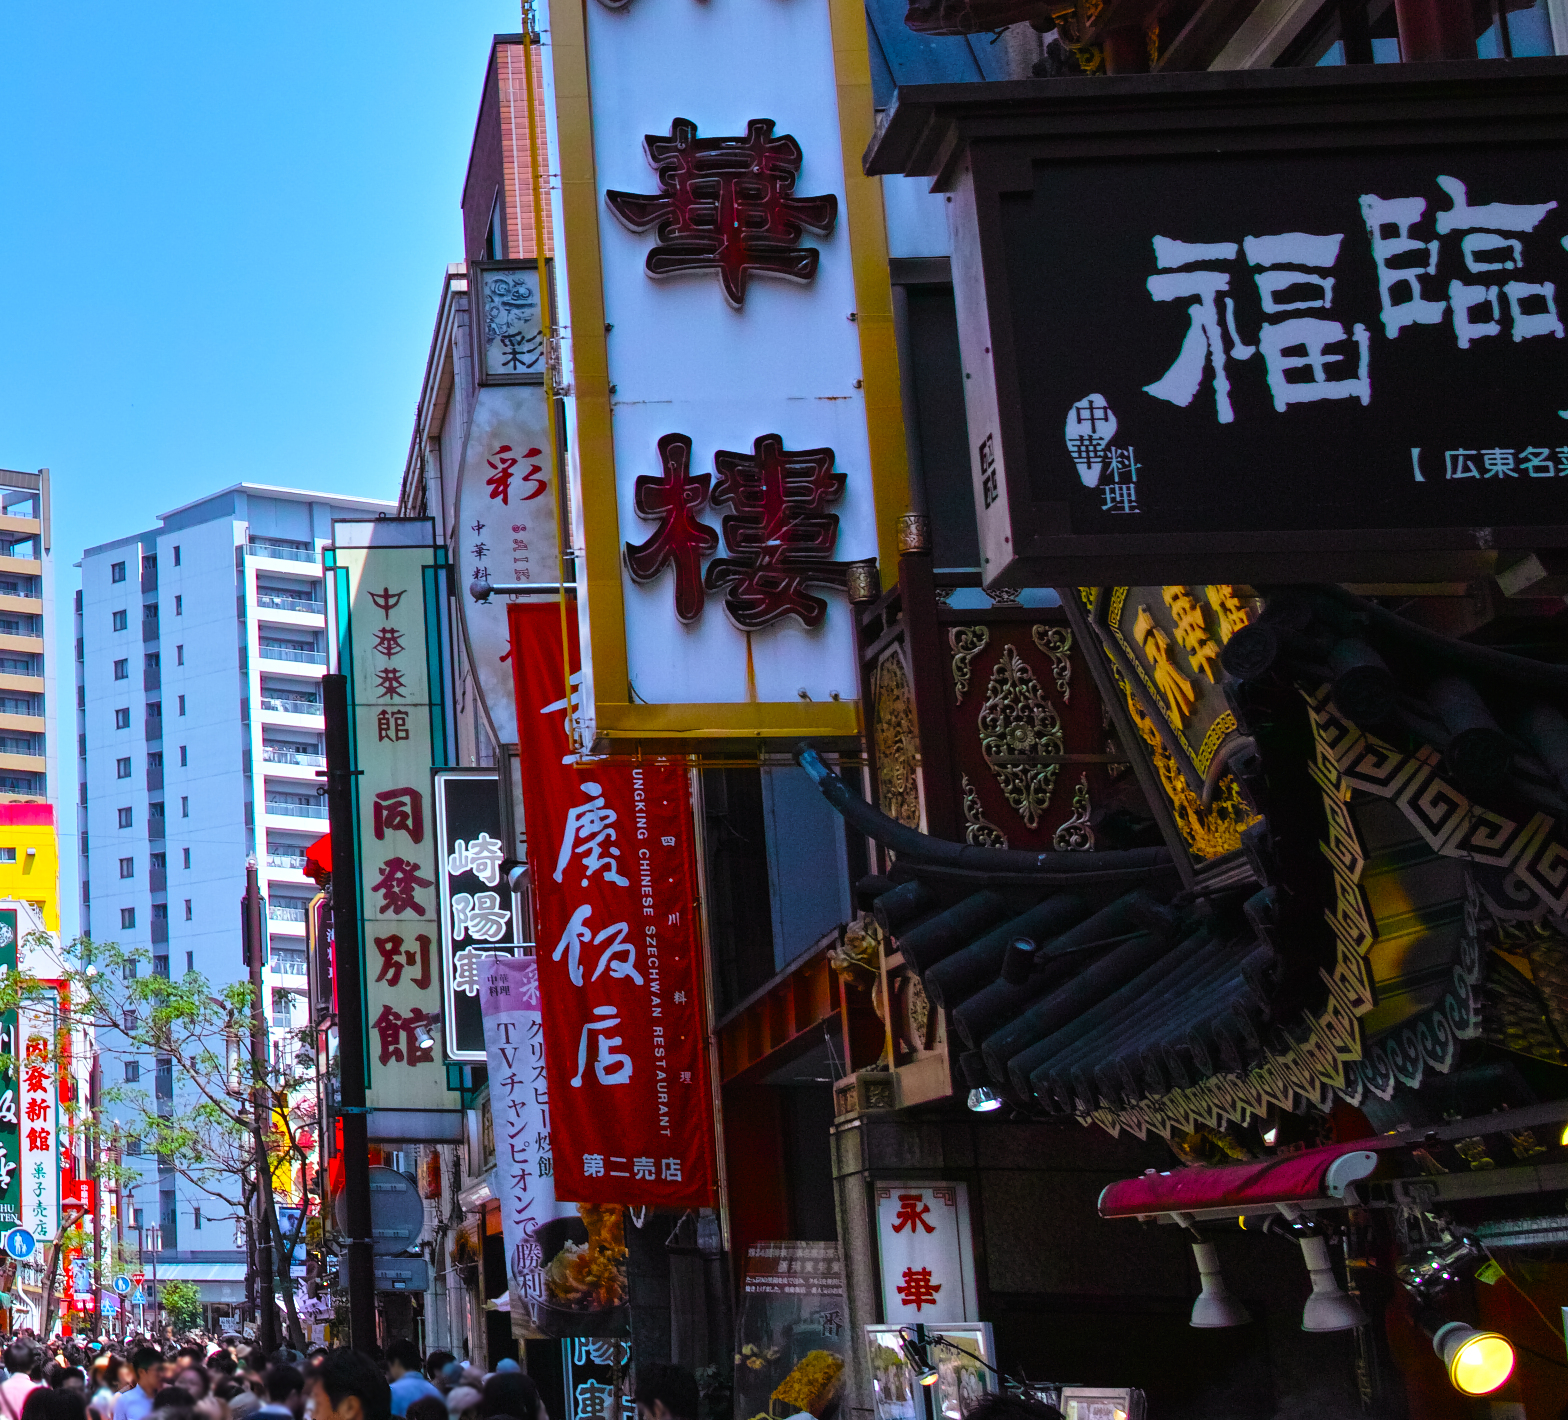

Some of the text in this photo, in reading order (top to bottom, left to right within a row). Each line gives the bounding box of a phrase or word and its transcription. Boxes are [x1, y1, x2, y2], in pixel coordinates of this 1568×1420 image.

[1141, 174, 1568, 423] 福臨
[486, 445, 548, 506] 彩
[1068, 399, 1142, 514] 中華 料理
[367, 587, 409, 742] 中華菜館
[638, 849, 655, 916] CHINESE
[645, 925, 663, 1018] SZECHWAN
[653, 1026, 671, 1137] RESTAURANT
[581, 1153, 683, 1182] 第二売店
[891, 1193, 942, 1312] 永華
